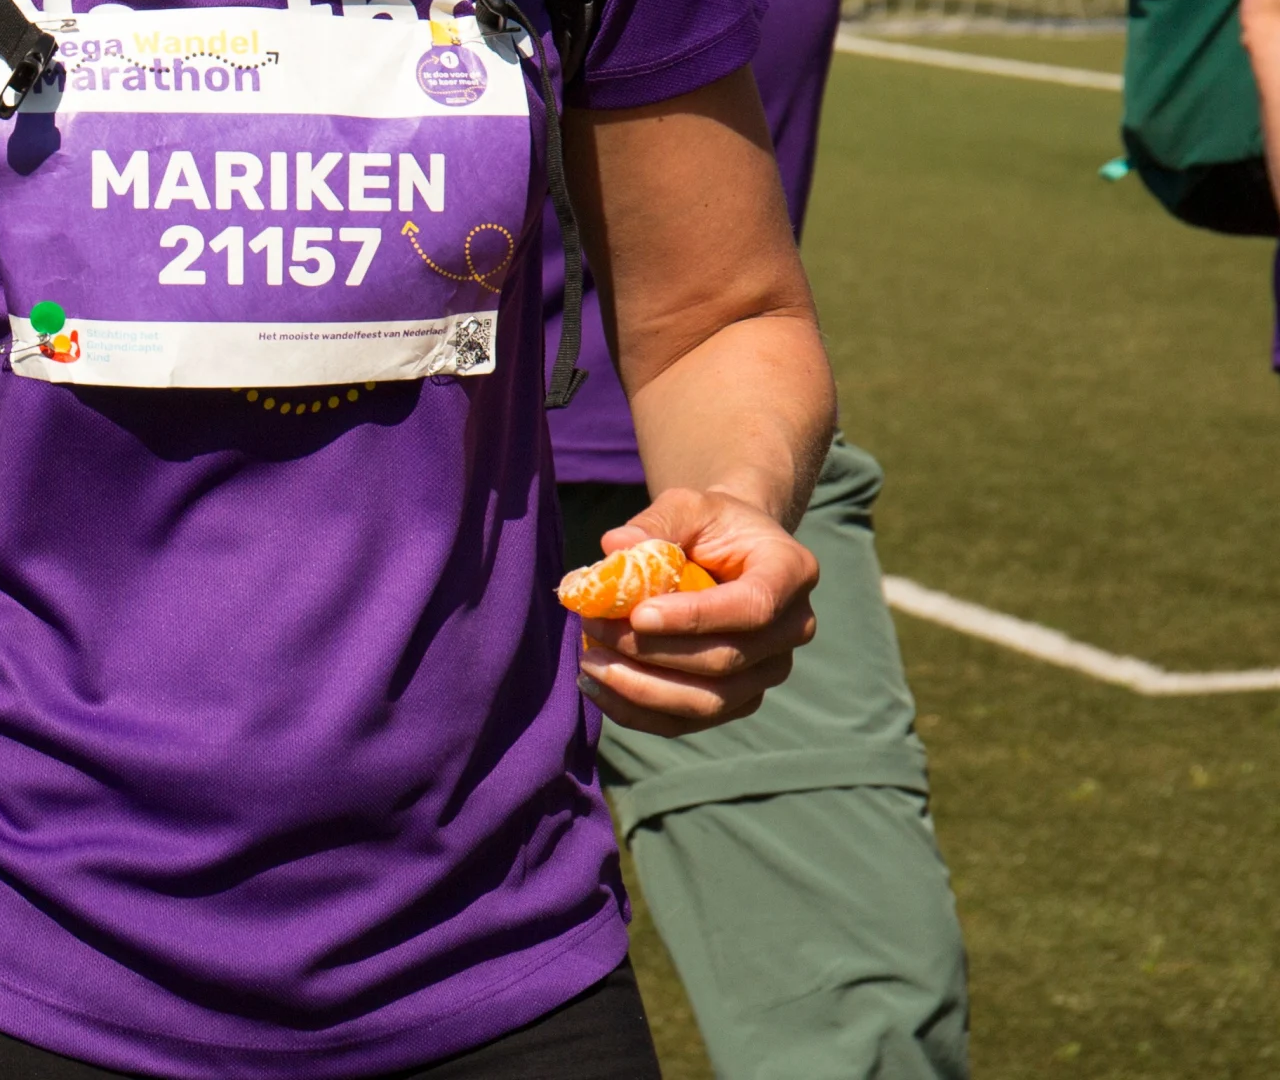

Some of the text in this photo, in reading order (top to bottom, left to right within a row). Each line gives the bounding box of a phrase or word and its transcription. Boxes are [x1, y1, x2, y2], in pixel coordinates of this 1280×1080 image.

[57, 30, 260, 62] ega Wandel
[91, 149, 445, 213] MARIKEN
[158, 224, 382, 286] 21157
[86, 328, 159, 342] Stichting het
[258, 331, 277, 341] Het
[279, 331, 320, 341] mooiste
[321, 329, 382, 340] wandelfeest
[383, 330, 401, 339] van
[86, 352, 111, 363] Kind
